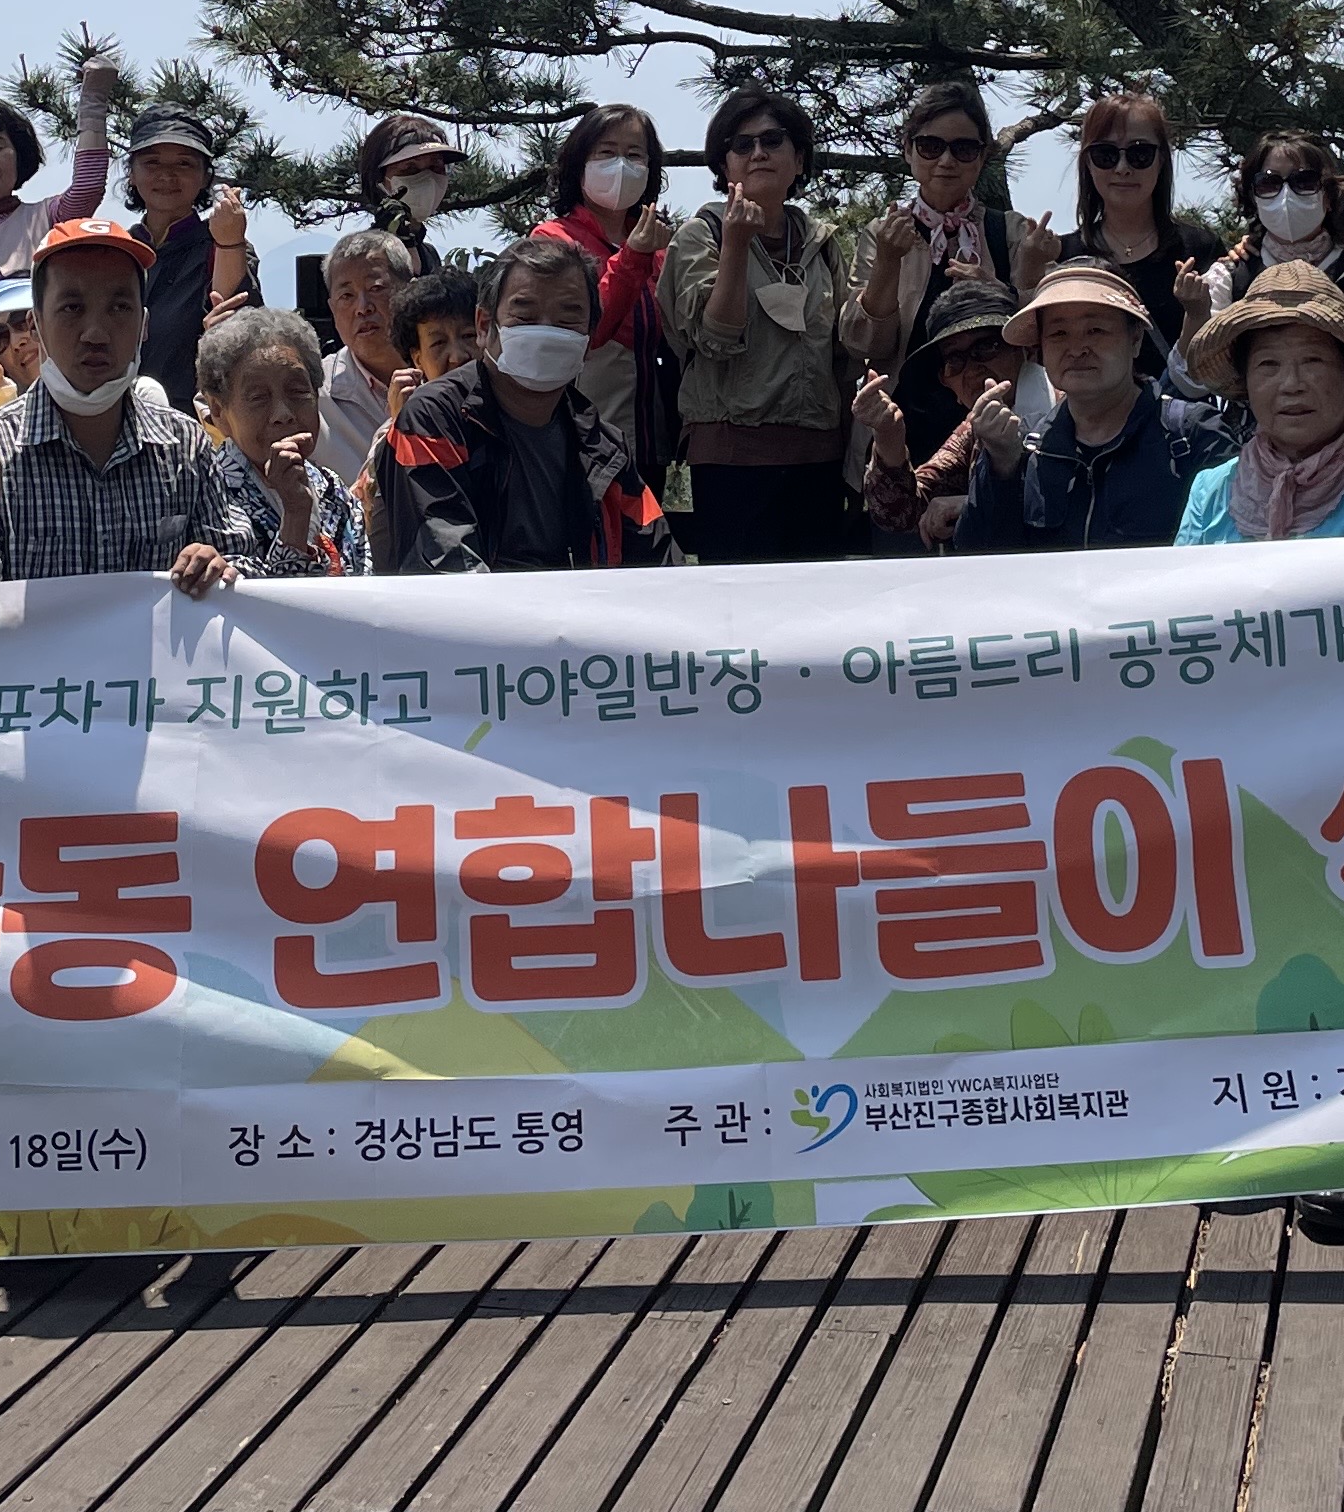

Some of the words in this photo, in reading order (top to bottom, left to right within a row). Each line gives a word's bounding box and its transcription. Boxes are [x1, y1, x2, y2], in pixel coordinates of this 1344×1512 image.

[79, 220, 111, 234] G
[186, 668, 432, 735] 지원하고
[454, 647, 768, 722] 가야일반장
[841, 626, 1081, 701] 아름드리
[256, 759, 1244, 1012] 연합나들이
[864, 1079, 945, 1099] 사회복지법인
[947, 1072, 1060, 1094] YWCA복지사업단
[864, 1089, 1130, 1132] 부산진구종합사회복지관
[9, 1128, 148, 1173] 18일(수)
[354, 1115, 502, 1163] 경상남도
[511, 1109, 585, 1155] 통영
